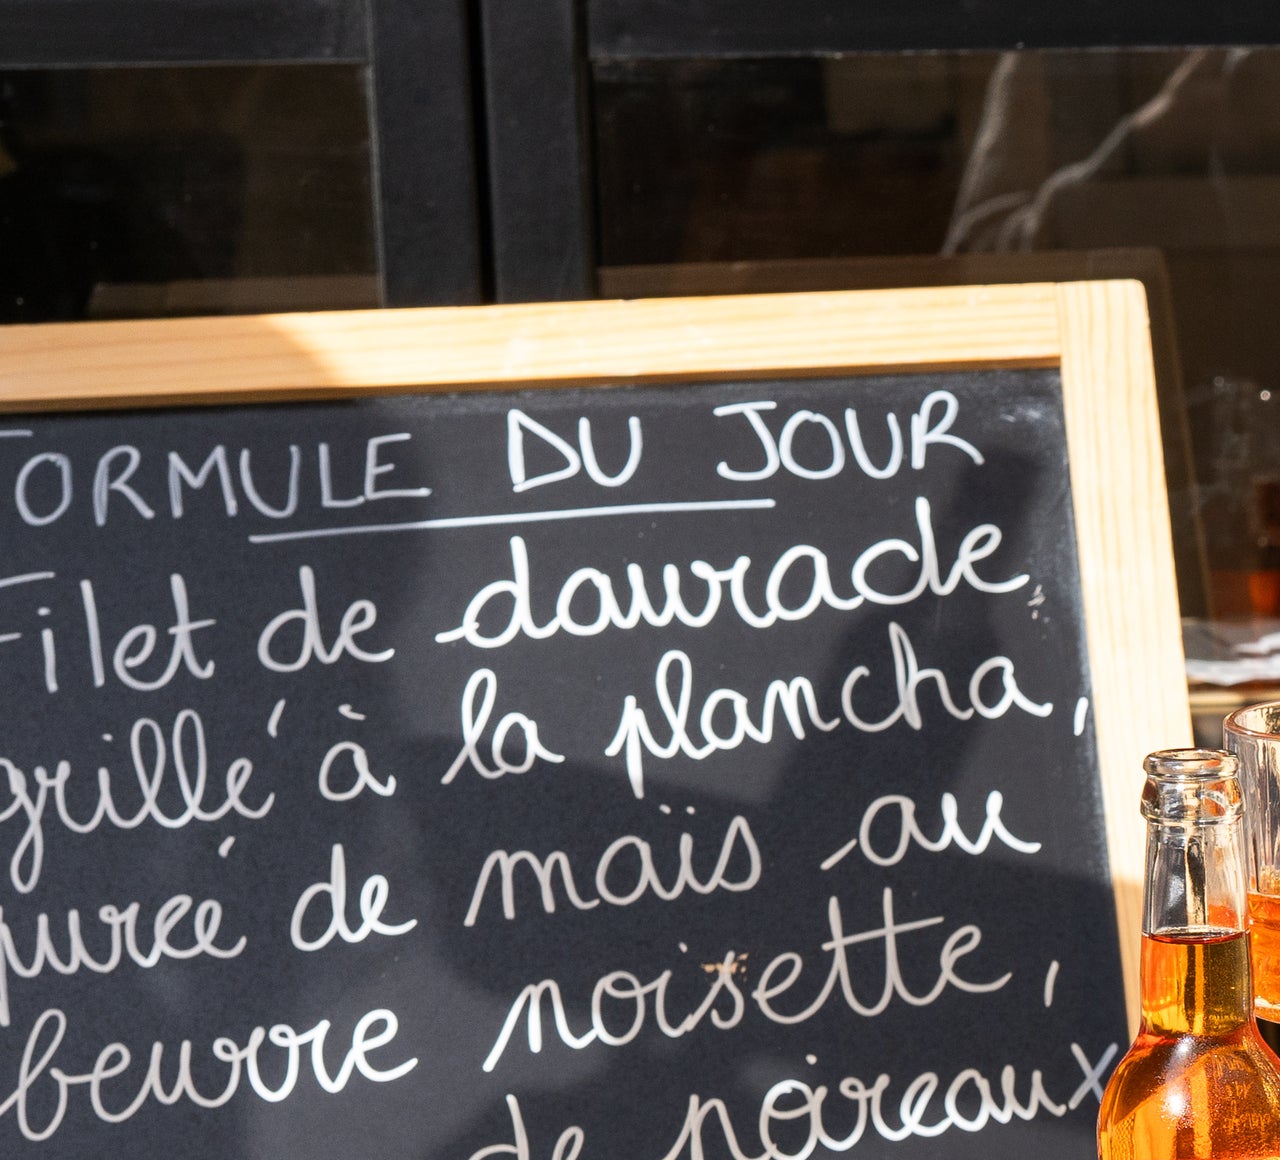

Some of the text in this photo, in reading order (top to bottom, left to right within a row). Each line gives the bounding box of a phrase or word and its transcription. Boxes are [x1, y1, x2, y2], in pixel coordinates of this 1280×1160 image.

[0, 390, 985, 528] ORMULE DU JOUR
[257, 564, 396, 673] de
[434, 496, 1031, 648] daurade
[318, 703, 397, 802] à
[441, 668, 566, 785] la
[290, 842, 418, 951] de
[463, 803, 762, 928] maïs
[820, 791, 1042, 869] au
[0, 1008, 418, 1142] beurre
